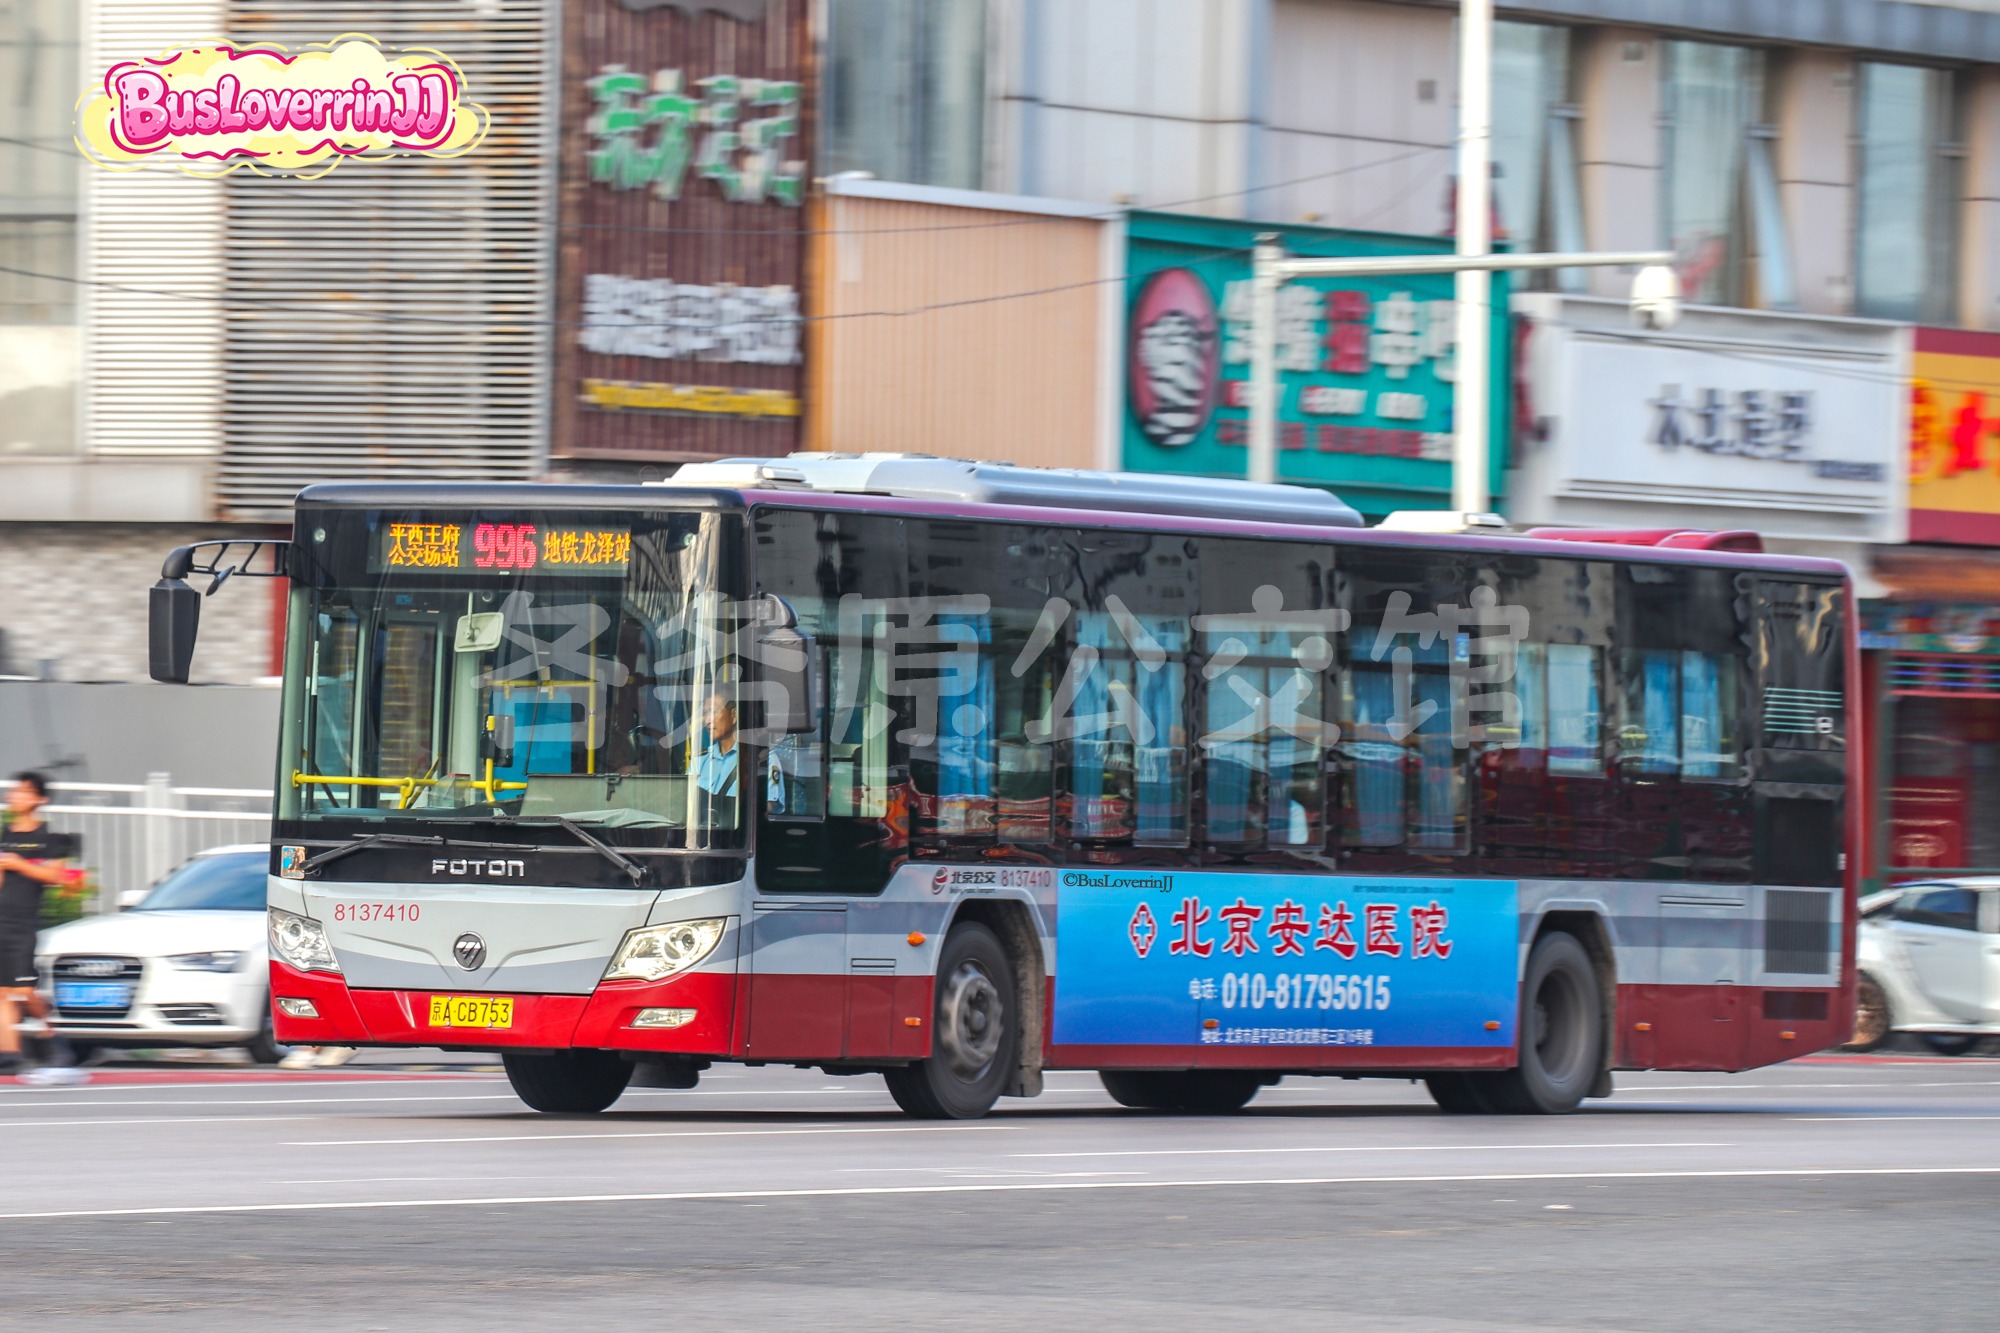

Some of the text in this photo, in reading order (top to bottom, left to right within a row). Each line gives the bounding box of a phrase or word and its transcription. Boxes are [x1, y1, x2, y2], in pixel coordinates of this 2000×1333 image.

[389, 523, 461, 546] 平西王府
[473, 523, 537, 568] 996
[388, 544, 460, 568] 公交场站
[543, 531, 631, 564] 地铁龙泽站
[431, 858, 526, 877] FOTON
[950, 871, 997, 884] 北京公交
[1000, 869, 1052, 888] 8137410
[334, 903, 421, 922] 8137410
[1168, 896, 1454, 960] 北京安达医院
[1221, 972, 1392, 1011] 010-81795615
